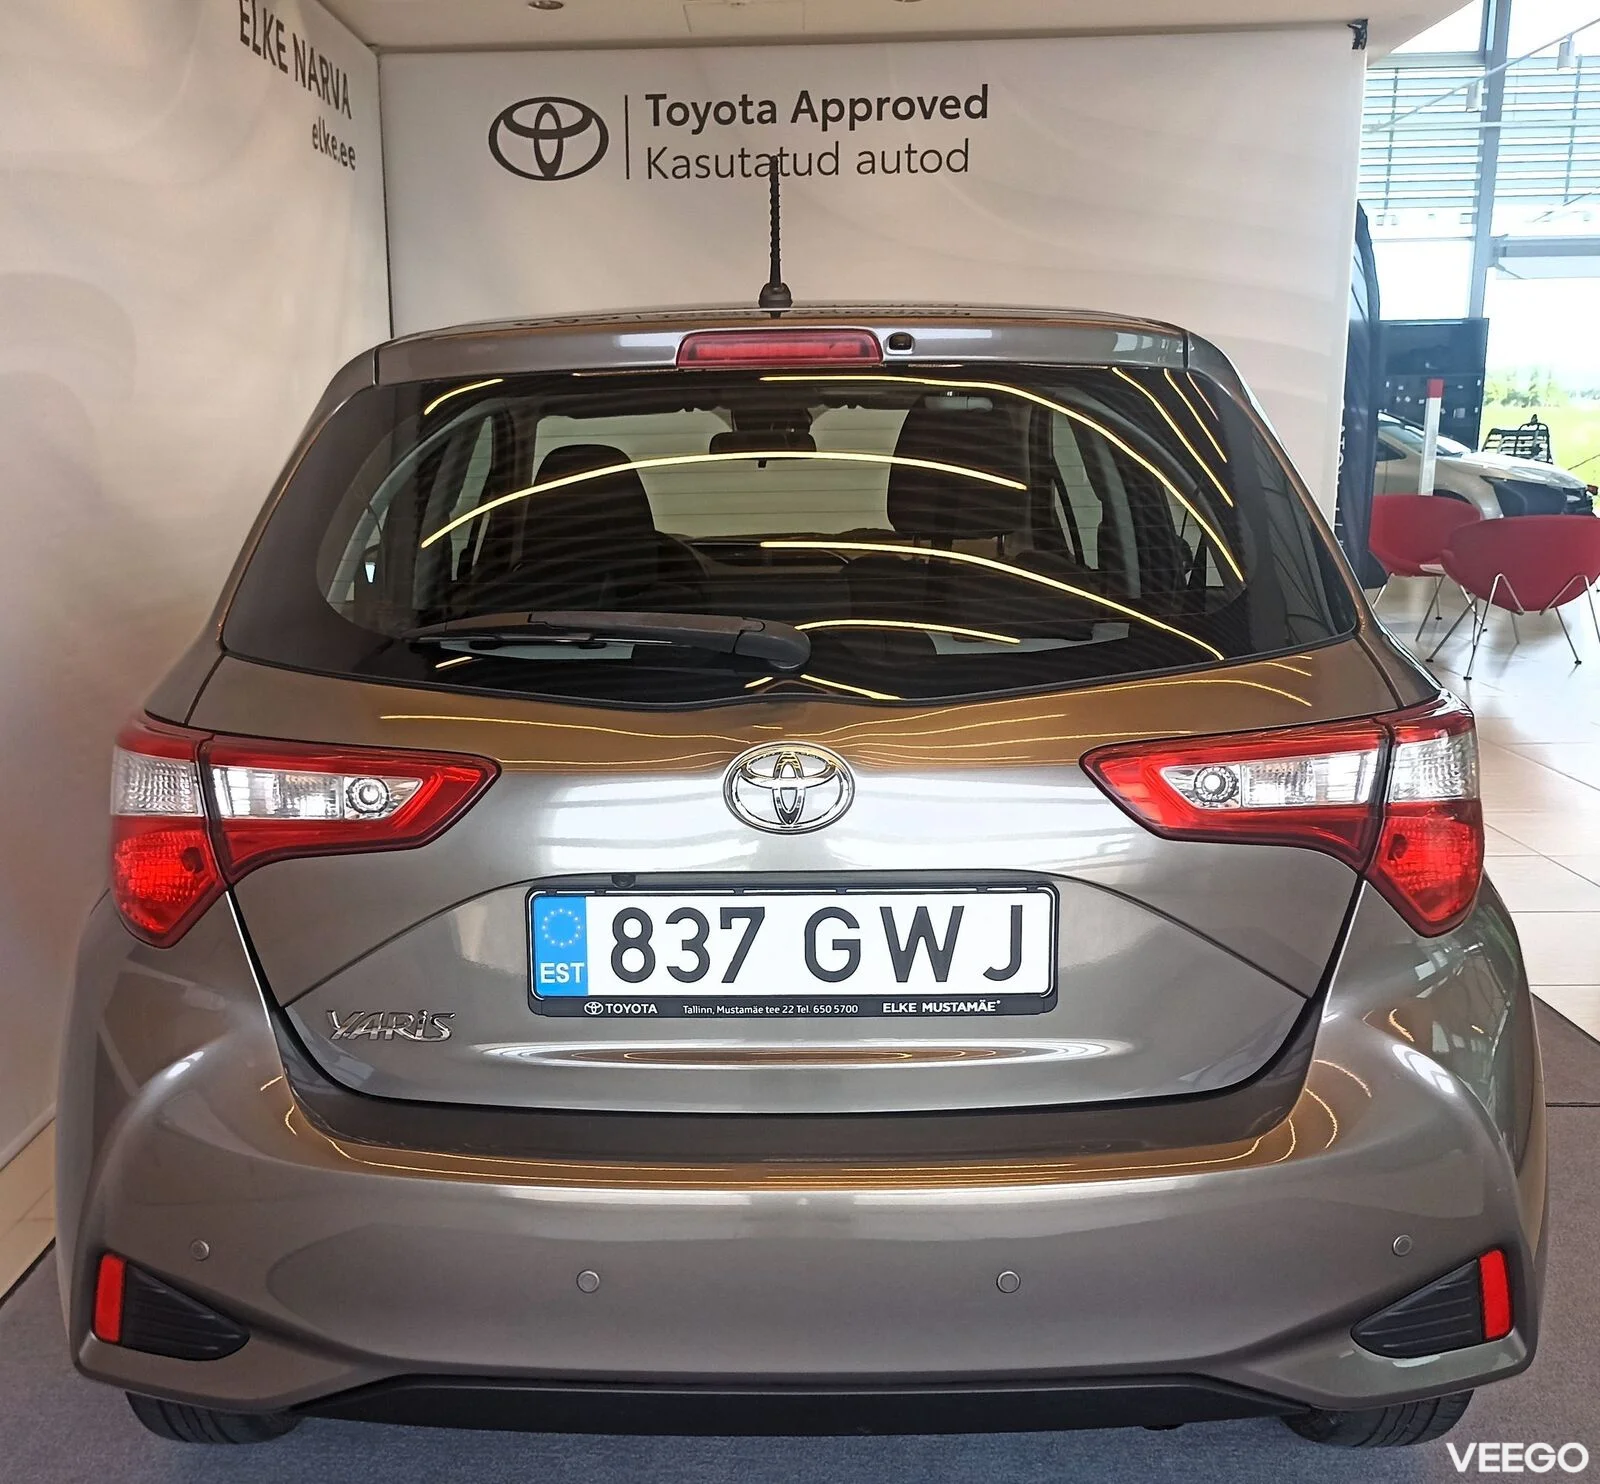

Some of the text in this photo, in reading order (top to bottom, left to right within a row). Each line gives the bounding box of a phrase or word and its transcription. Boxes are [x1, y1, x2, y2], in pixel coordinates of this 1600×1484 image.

[238, 0, 352, 119] ELKE NARVA
[645, 83, 990, 135] Toyota Approved
[312, 116, 356, 170] elke.ee
[647, 137, 970, 181] Kasutatud autod
[610, 904, 1023, 984] 837 GWJ
[540, 962, 585, 984] EST
[606, 1003, 658, 1014] TOYOTA
[682, 1004, 859, 1015] Tallinn, Mustamäe tee 22 Tel. 650 5700
[882, 1002, 917, 1013] ELKE
